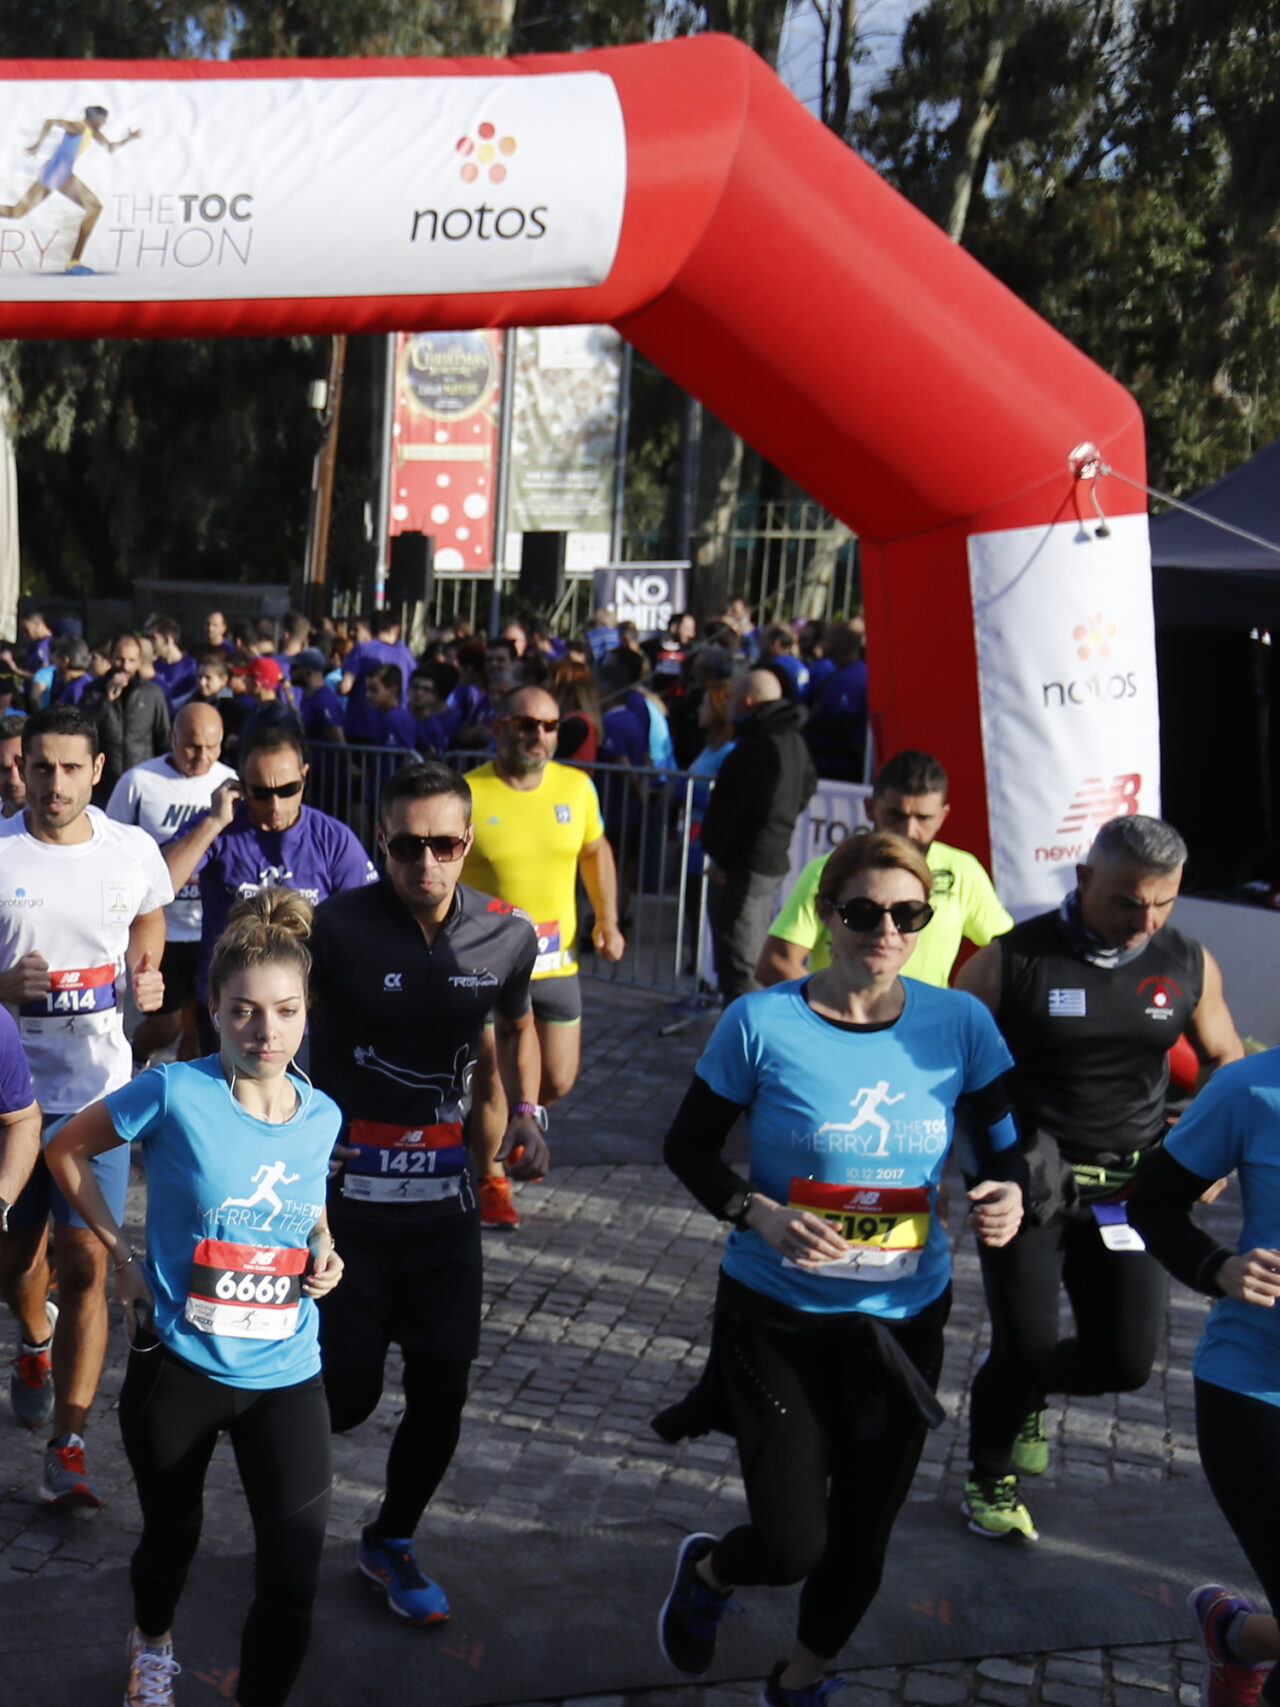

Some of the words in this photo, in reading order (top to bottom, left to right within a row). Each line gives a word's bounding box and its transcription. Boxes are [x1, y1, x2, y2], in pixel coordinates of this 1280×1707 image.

[411, 203, 549, 242] notos
[109, 227, 253, 268] THON
[615, 574, 669, 605] NO
[1042, 671, 1138, 709] notos
[1035, 844, 1083, 862] new
[46, 988, 96, 1012] 1414
[791, 1130, 872, 1154] MERRY
[379, 1149, 437, 1173] 1421
[215, 1270, 292, 1305] 6669
